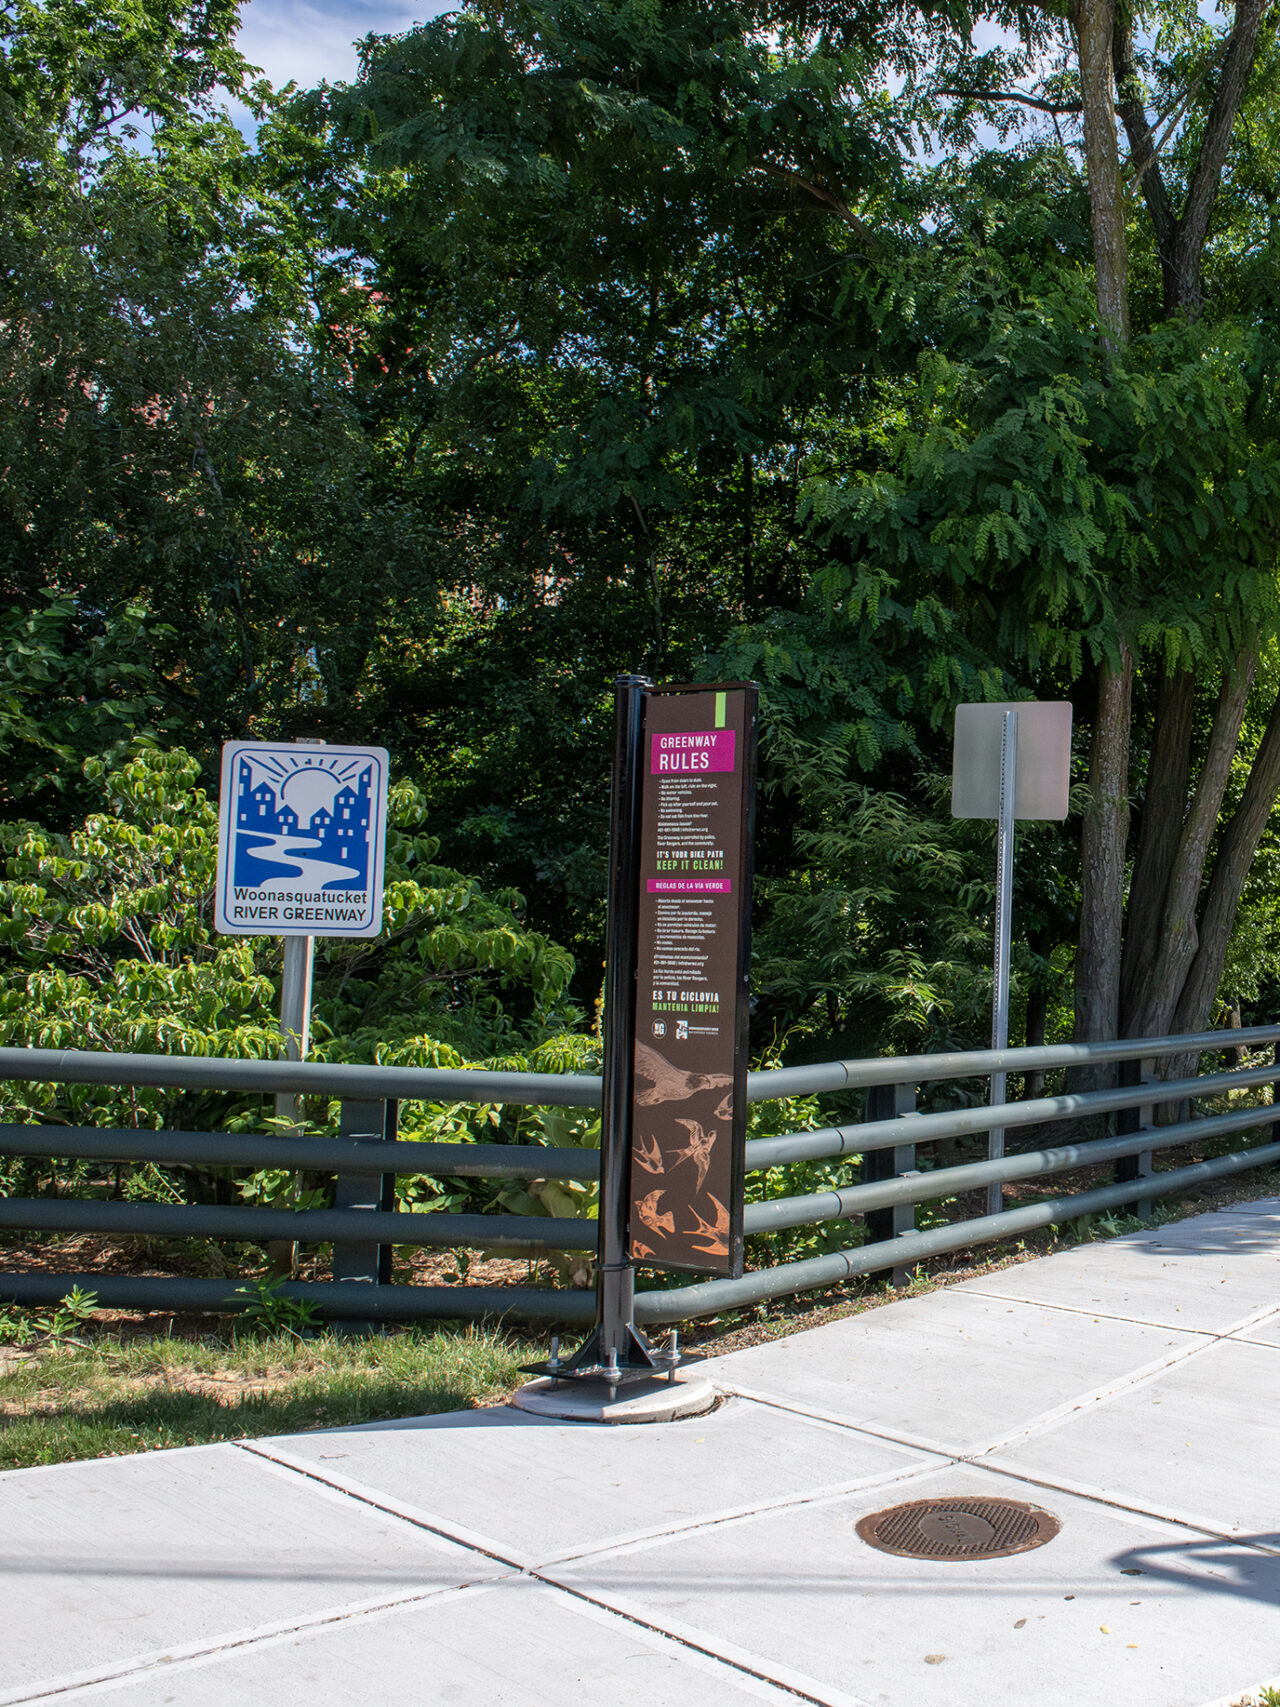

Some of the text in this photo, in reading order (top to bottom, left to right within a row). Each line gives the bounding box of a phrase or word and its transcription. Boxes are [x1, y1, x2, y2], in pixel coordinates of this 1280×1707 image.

[660, 735, 717, 748] GREENWAY
[660, 752, 709, 770] RULES
[656, 850, 723, 859] IT'S YOUR BIKE PATH
[656, 860, 723, 870] KEEP IT CLEAN!
[694, 881, 704, 889] VÍA
[234, 887, 367, 904] Woonasquatucket
[233, 906, 367, 921] RIVER GREENWAY
[652, 990, 719, 1002] ES TU CICLOVIA
[691, 1003, 719, 1013] LIMPIA!
